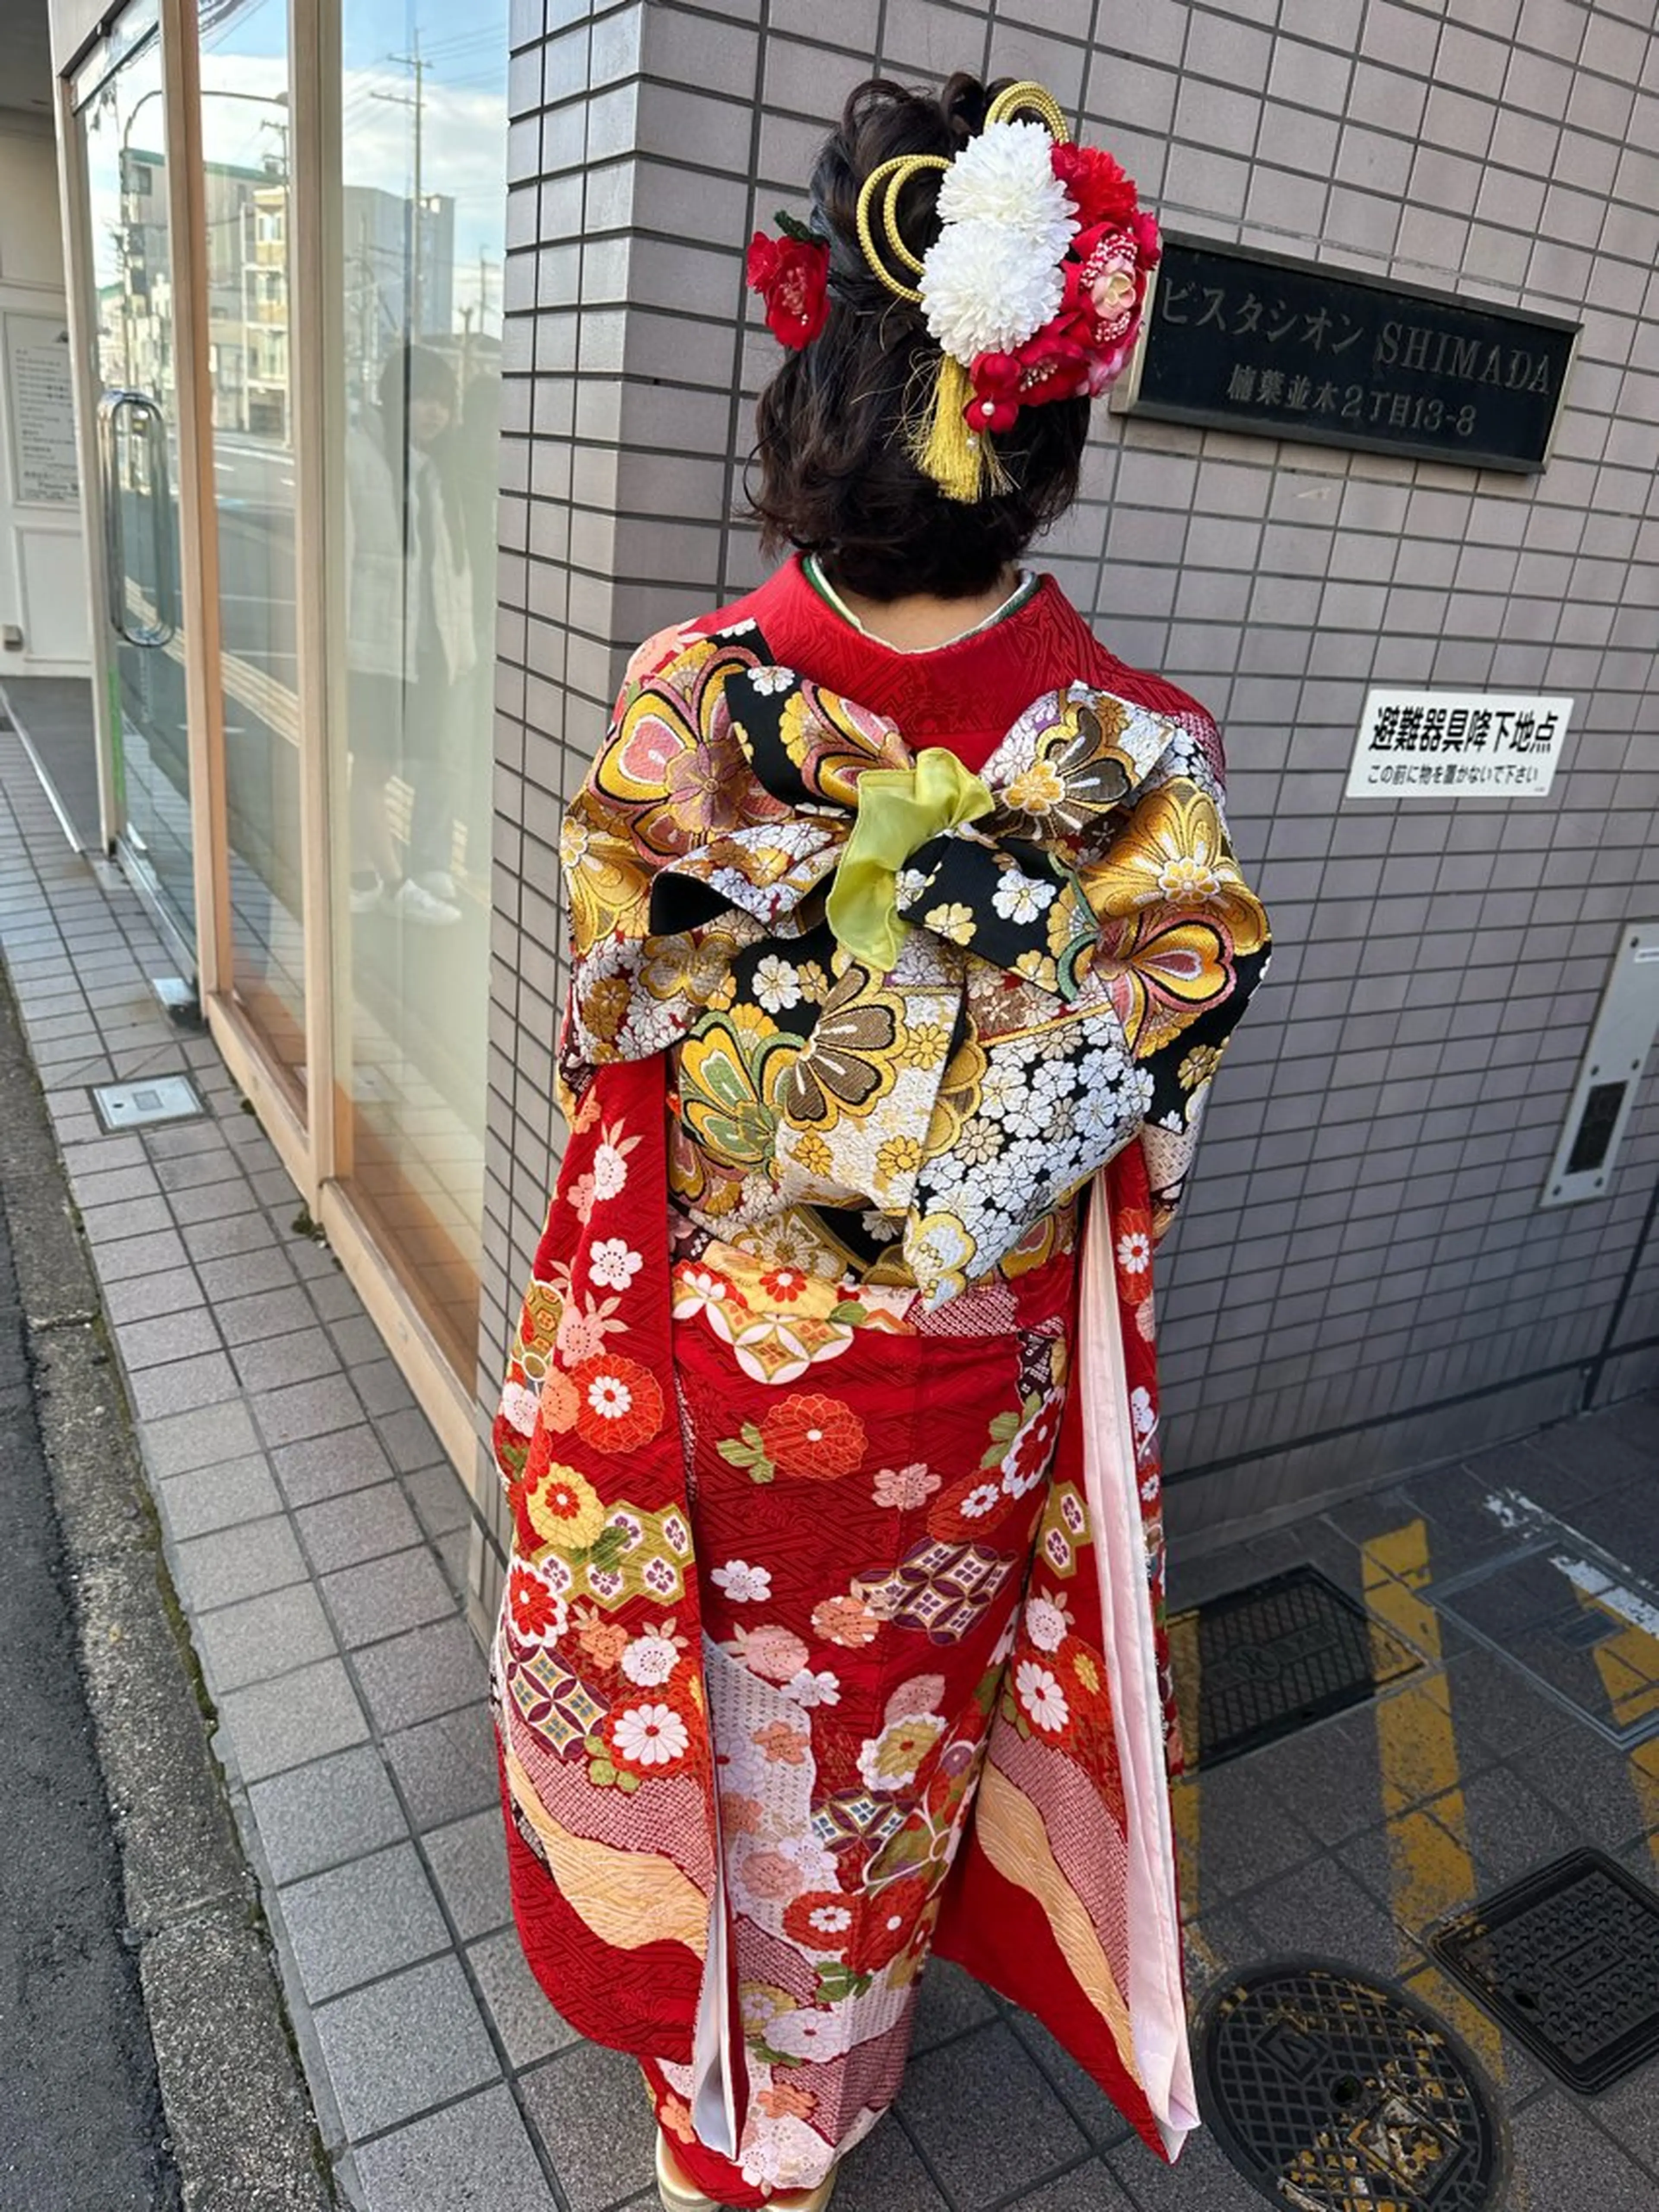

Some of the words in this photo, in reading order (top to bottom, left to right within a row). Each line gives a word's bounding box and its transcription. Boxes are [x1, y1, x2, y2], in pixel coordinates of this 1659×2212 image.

[1160, 278, 1363, 355] ビスタシオン
[1378, 321, 1550, 395] SHIMADA
[1369, 706, 1558, 753] 避難器具降下地点
[1367, 764, 1538, 785] この前に物を置かないで下さい
